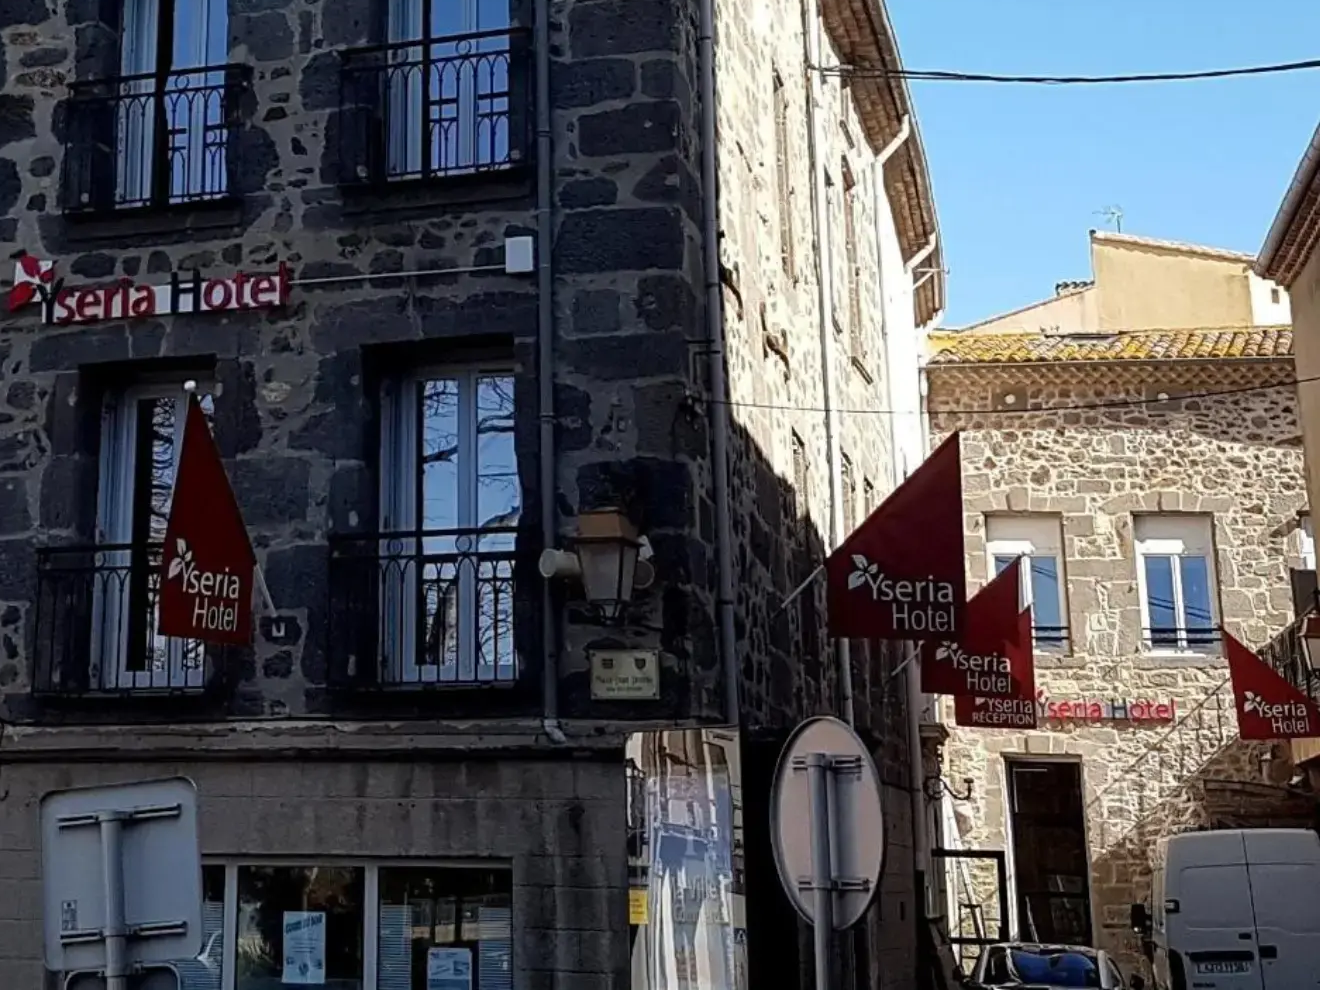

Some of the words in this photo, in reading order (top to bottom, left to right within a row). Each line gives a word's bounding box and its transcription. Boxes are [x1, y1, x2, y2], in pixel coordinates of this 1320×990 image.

[36, 275, 157, 326] Yseria
[169, 260, 292, 314] Hotel
[182, 561, 240, 599] Yseria
[865, 573, 954, 602] Yseria
[192, 596, 238, 632] Hotel
[892, 603, 955, 632] Hotel
[949, 648, 1011, 673] Yseria
[966, 672, 1011, 693] Hotel
[986, 694, 1033, 714] Yseria
[1037, 696, 1102, 721] Yseria
[1111, 696, 1175, 722] Hotel
[1253, 699, 1307, 718] Yseria
[972, 710, 1034, 725] RÉCEPTION
[1271, 717, 1310, 733] Hotel
